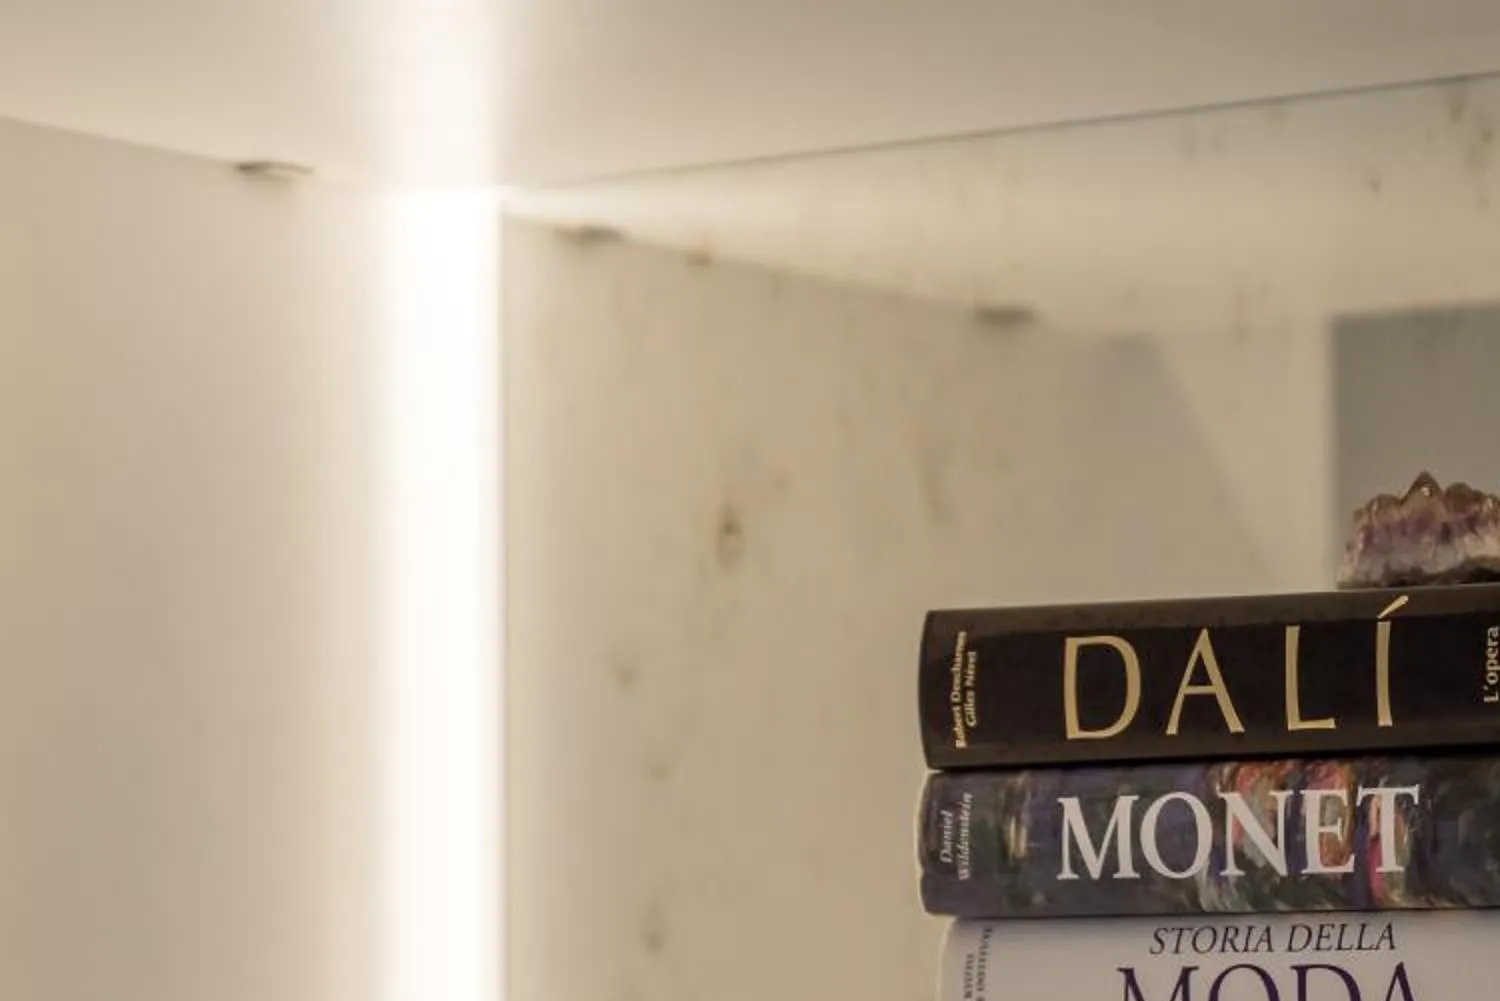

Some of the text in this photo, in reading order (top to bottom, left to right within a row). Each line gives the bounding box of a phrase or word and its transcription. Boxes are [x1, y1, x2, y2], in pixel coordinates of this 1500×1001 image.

[1063, 594, 1410, 740] DALÍ
[939, 809, 954, 863] Daniel
[1056, 784, 1419, 880] MONET
[1149, 922, 1397, 955] STORIA DELLA
